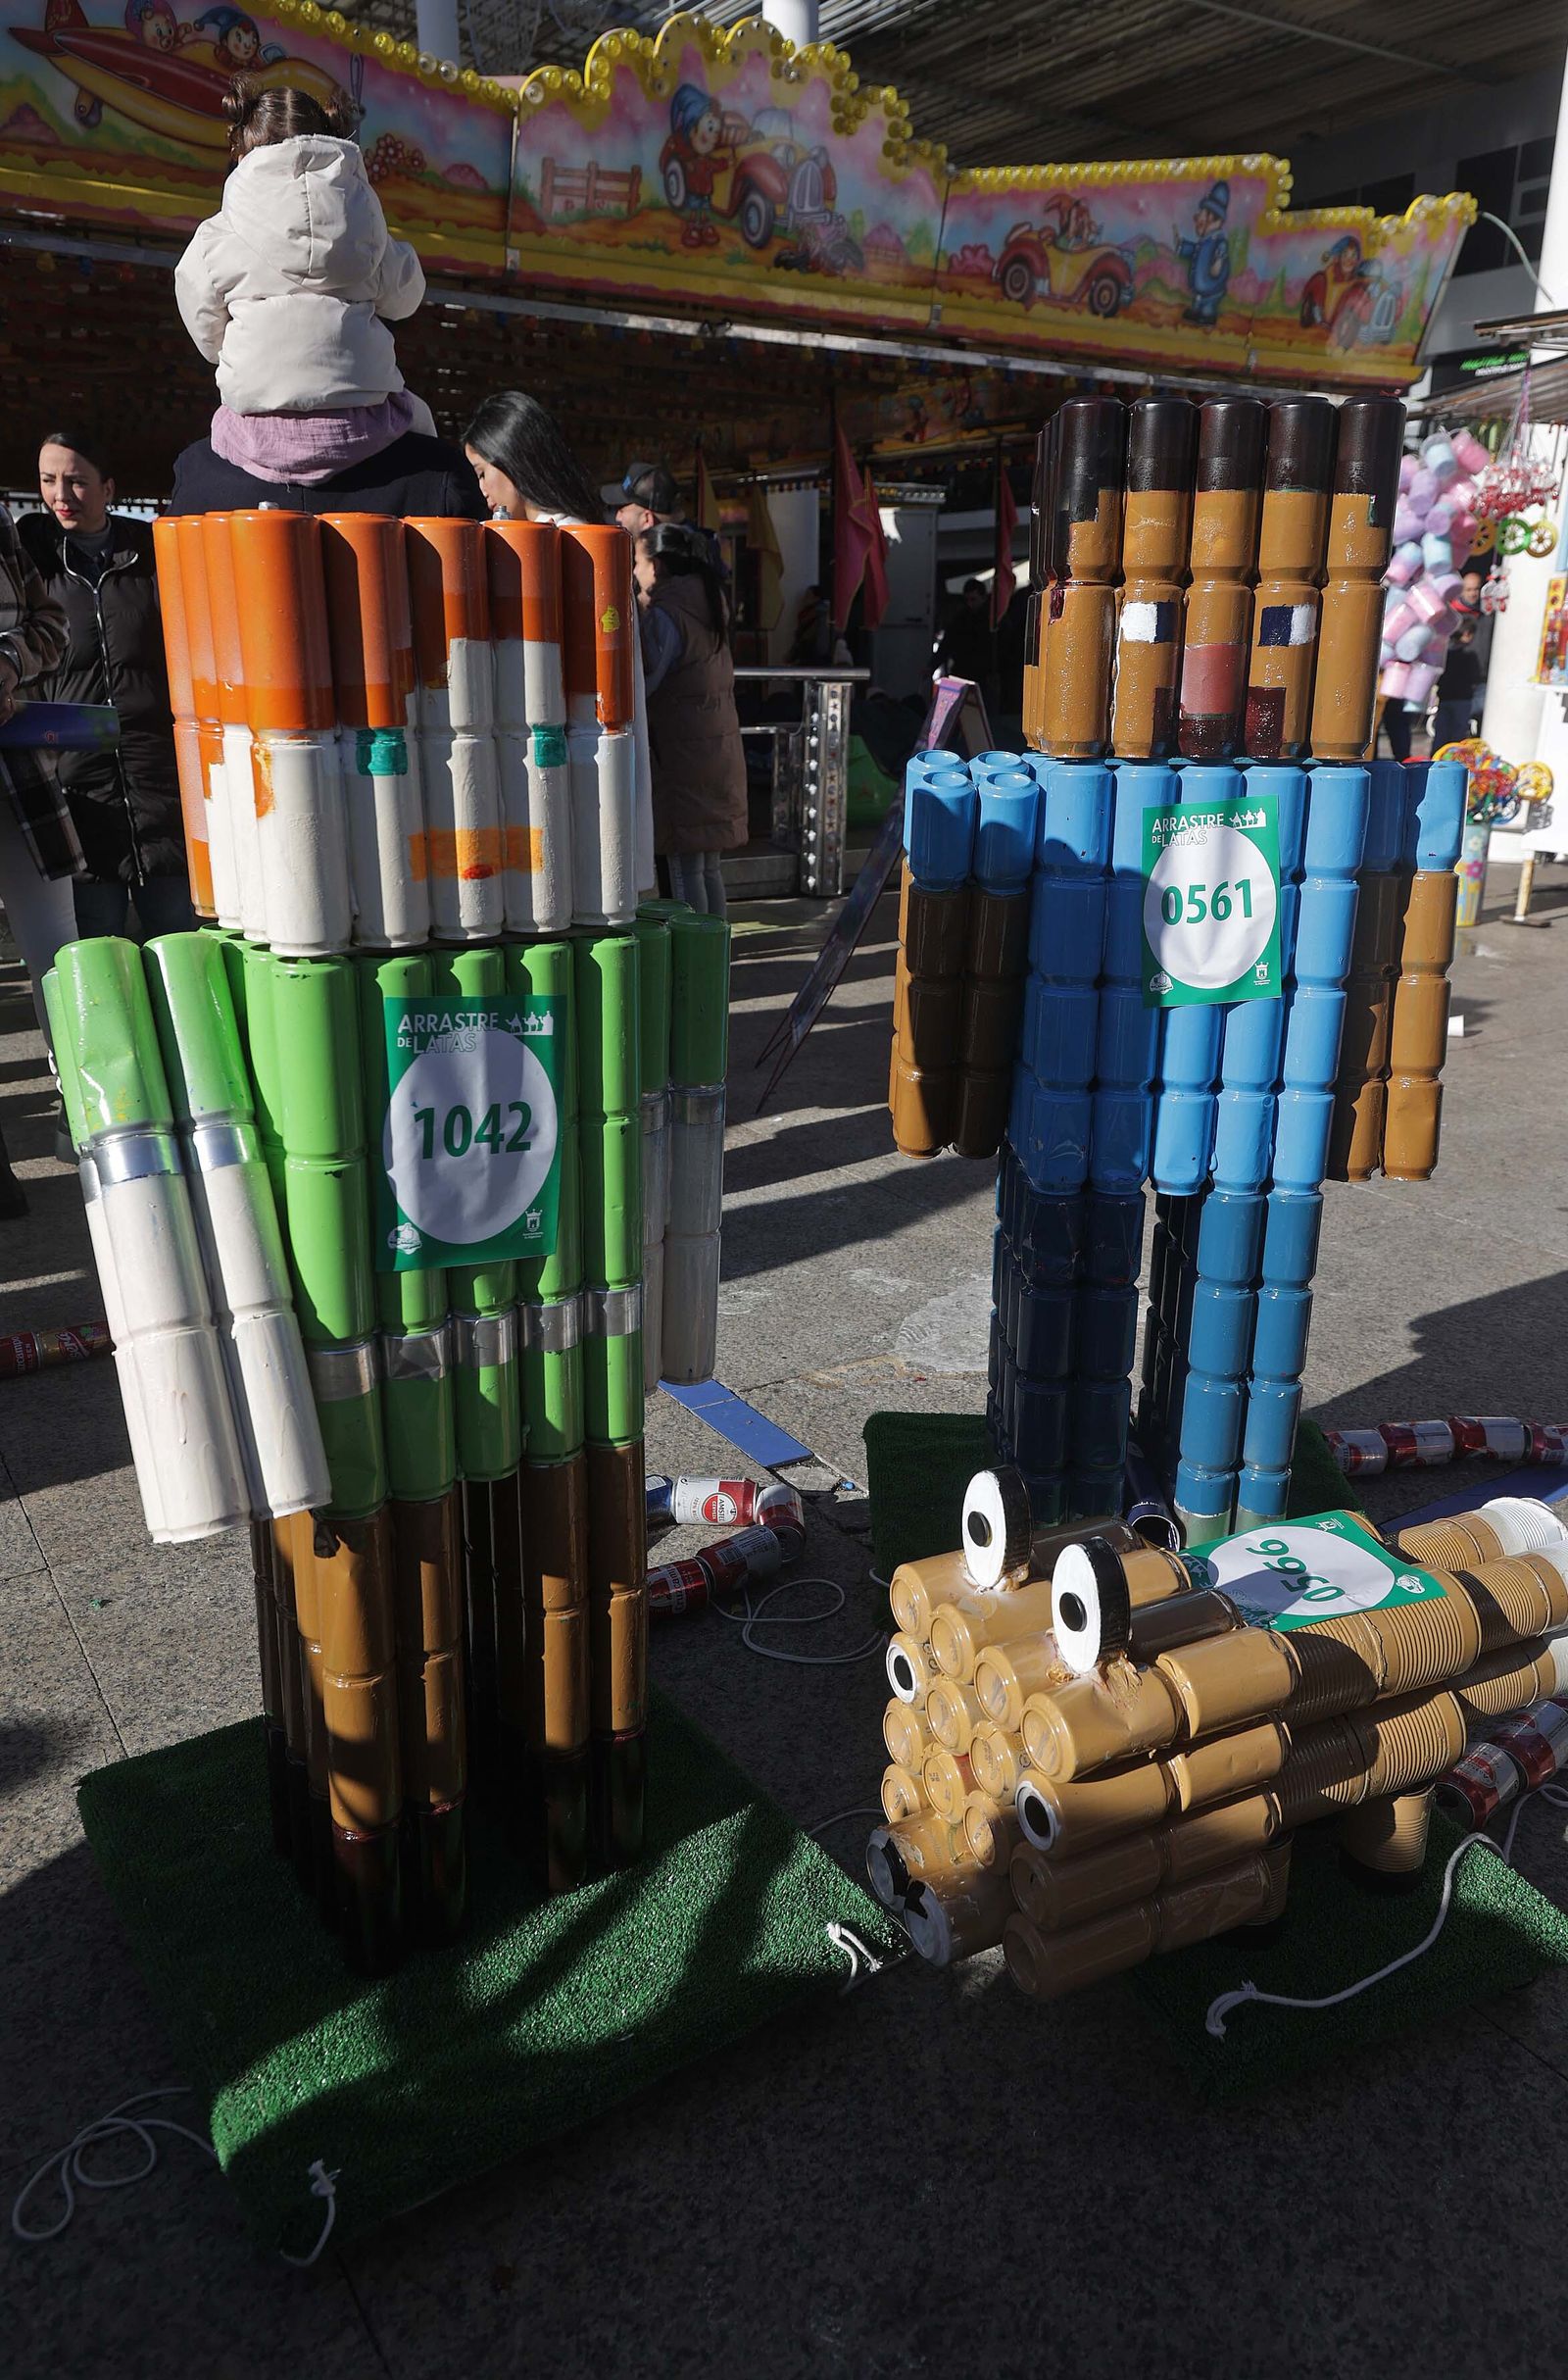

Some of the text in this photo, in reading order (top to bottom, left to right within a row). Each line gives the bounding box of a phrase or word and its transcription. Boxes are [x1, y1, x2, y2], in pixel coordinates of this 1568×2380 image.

[1152, 813, 1225, 833] ARRASTRE
[1152, 830, 1208, 847] DE LATAS
[1161, 878, 1253, 926] 0561
[397, 1012, 499, 1033] ARRASTRE
[397, 1032, 477, 1055] DE LATAS
[414, 1101, 532, 1160] 1042
[1246, 1539, 1346, 1602] 0566
